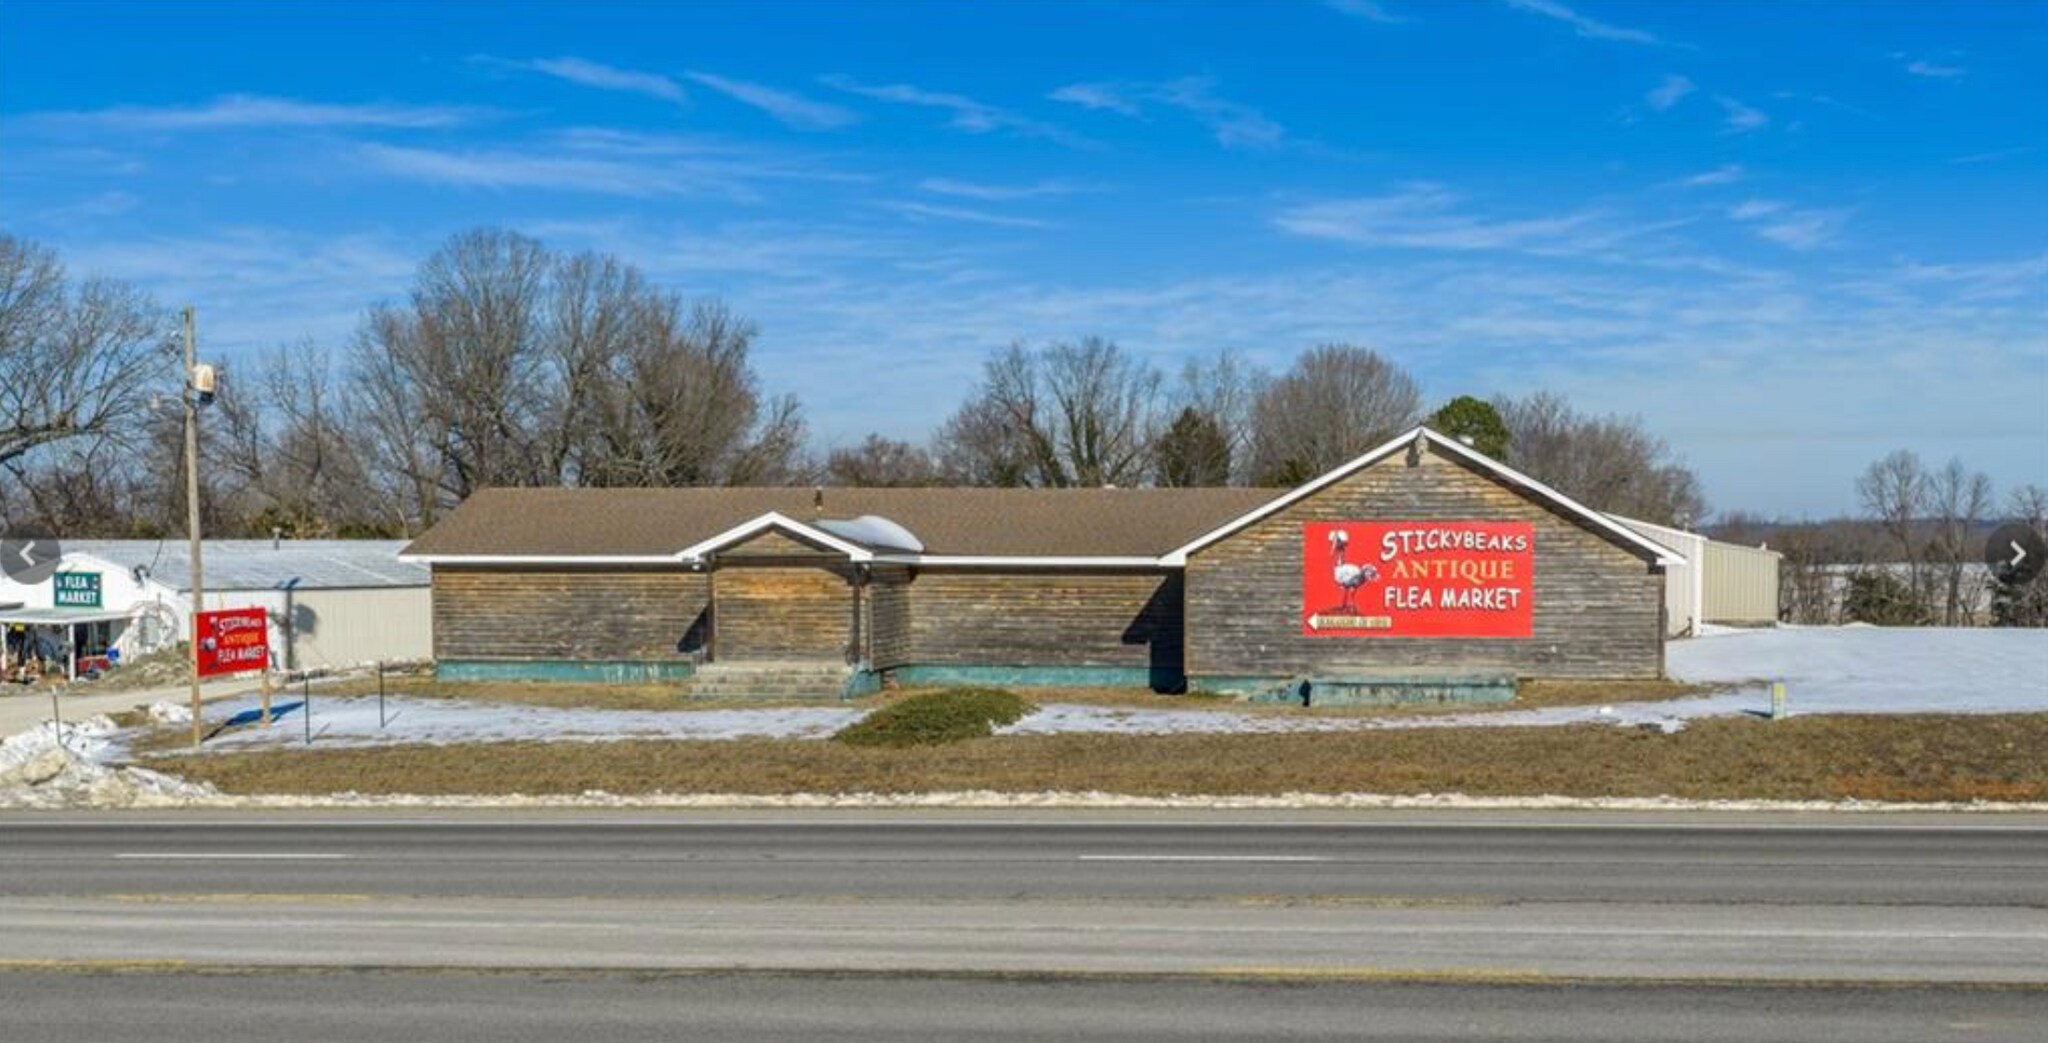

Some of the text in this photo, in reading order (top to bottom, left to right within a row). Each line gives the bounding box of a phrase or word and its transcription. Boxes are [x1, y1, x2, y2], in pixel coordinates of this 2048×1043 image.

[1381, 529, 1527, 561] STICKYBEAKS
[65, 575, 89, 589] FLEA
[1392, 559, 1516, 585] ANTIQUE
[58, 590, 97, 604] MARKET
[1384, 586, 1522, 609] FLEA MARKET
